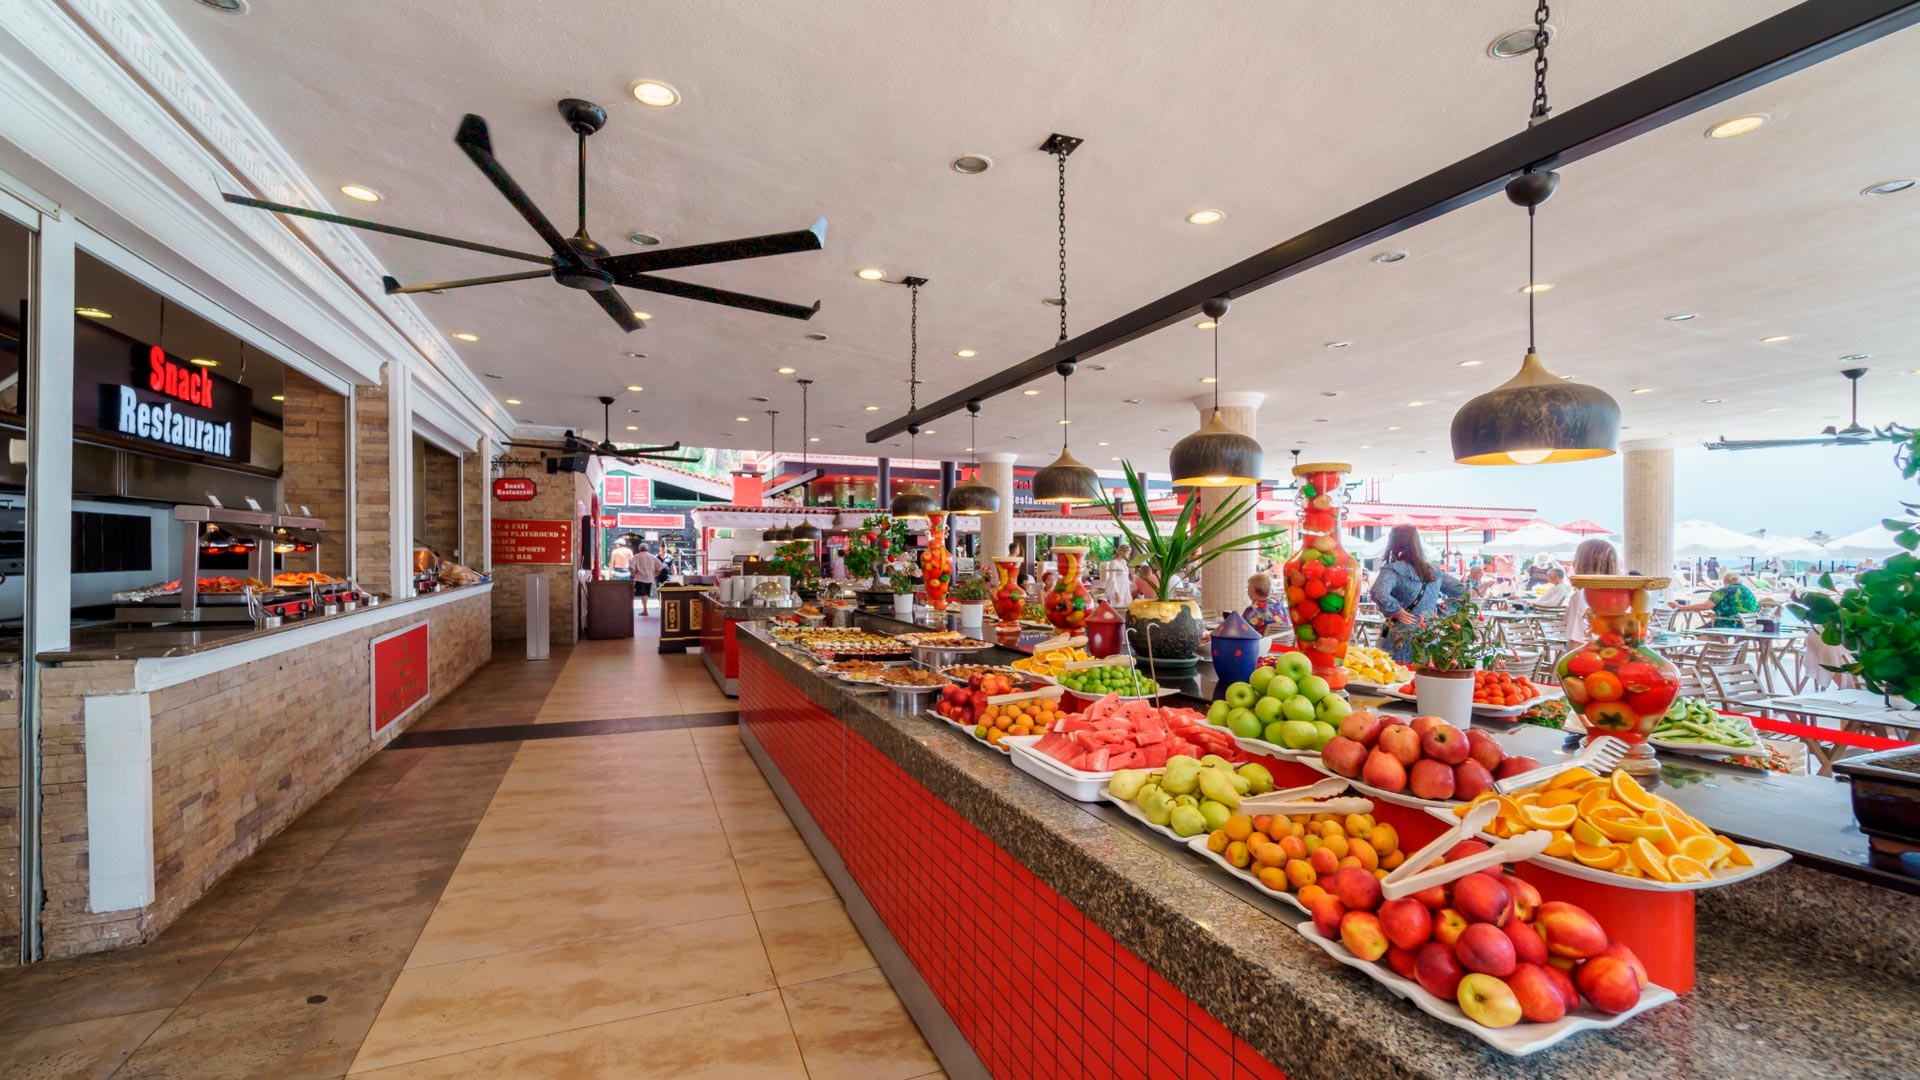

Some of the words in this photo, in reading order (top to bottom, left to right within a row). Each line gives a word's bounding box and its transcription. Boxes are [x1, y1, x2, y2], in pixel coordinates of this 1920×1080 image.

[149, 344, 213, 409] Snack
[118, 384, 232, 458] Restaurant
[1013, 479, 1033, 490] Pool
